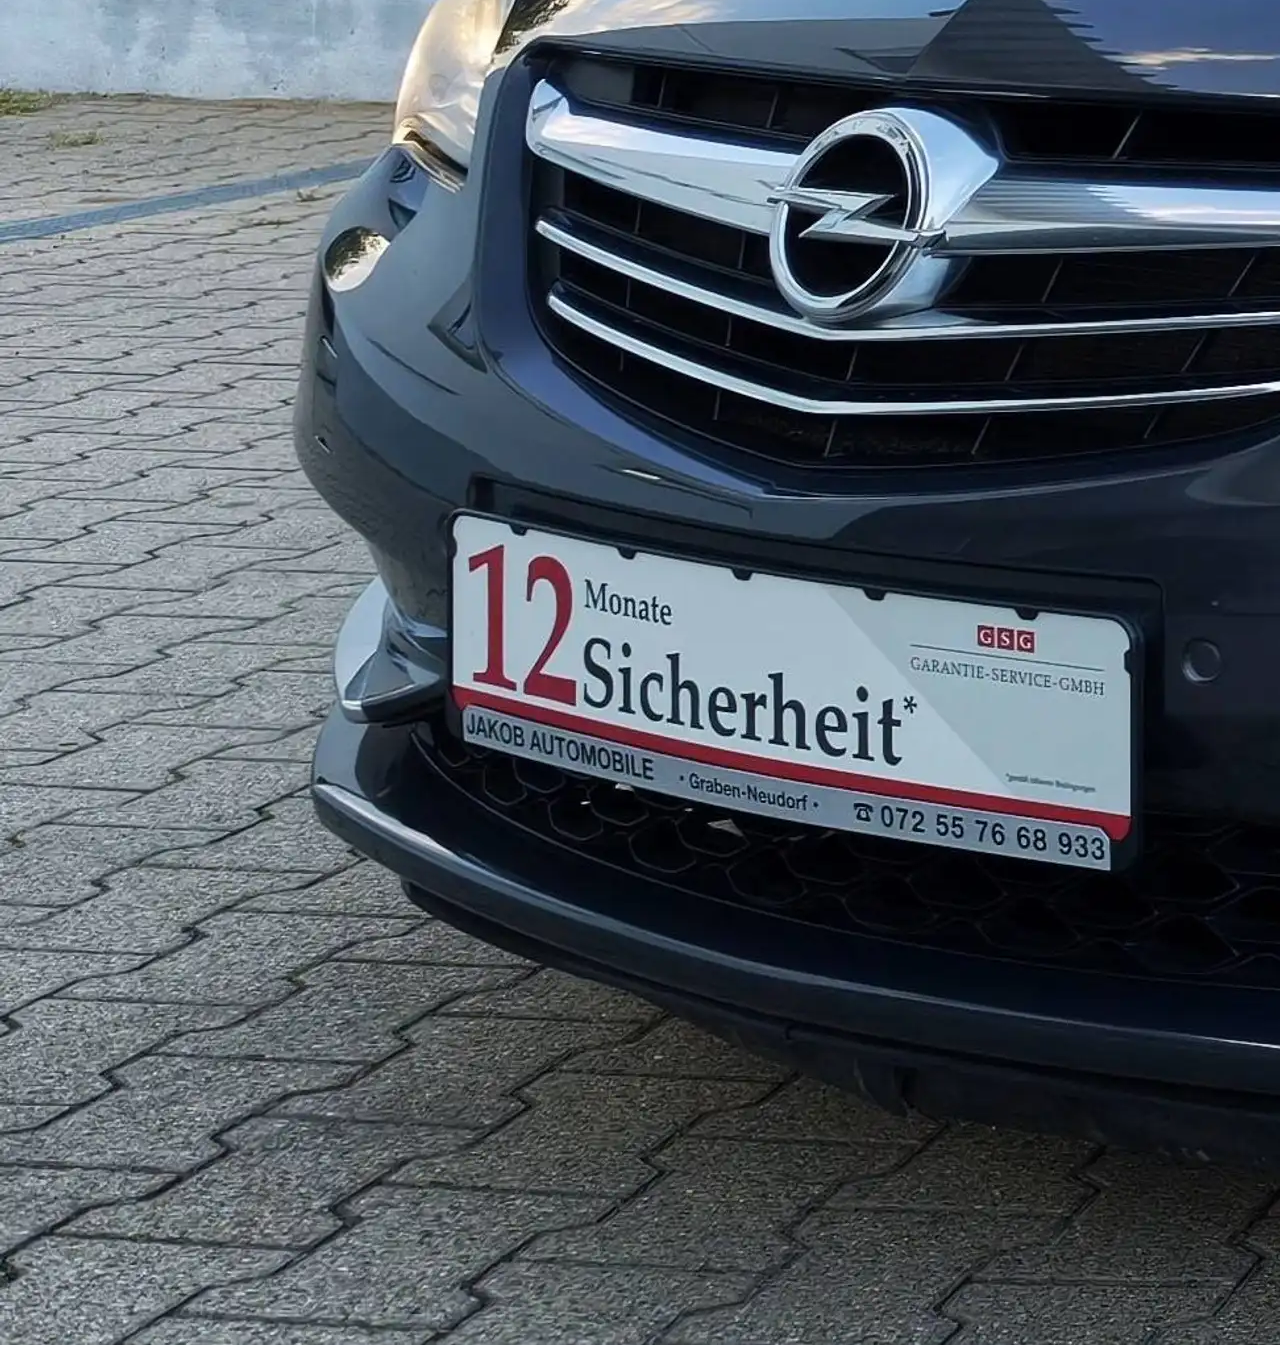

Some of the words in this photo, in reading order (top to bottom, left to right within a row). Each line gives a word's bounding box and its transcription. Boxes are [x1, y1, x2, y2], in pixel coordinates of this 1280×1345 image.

[468, 544, 577, 706] 12
[584, 579, 672, 626] Monate
[978, 626, 1035, 653] GSG
[910, 656, 1105, 697] GARANTIE-SERVICE-GMBH
[466, 712, 525, 749] JAKOB
[529, 729, 655, 781] AUTOMOBILE
[689, 772, 807, 812] Graben-Neudorf
[881, 805, 925, 835] 072
[936, 813, 965, 840] 55
[975, 818, 1006, 846] 76
[1016, 825, 1047, 852] 68
[1058, 830, 1105, 861] 933
